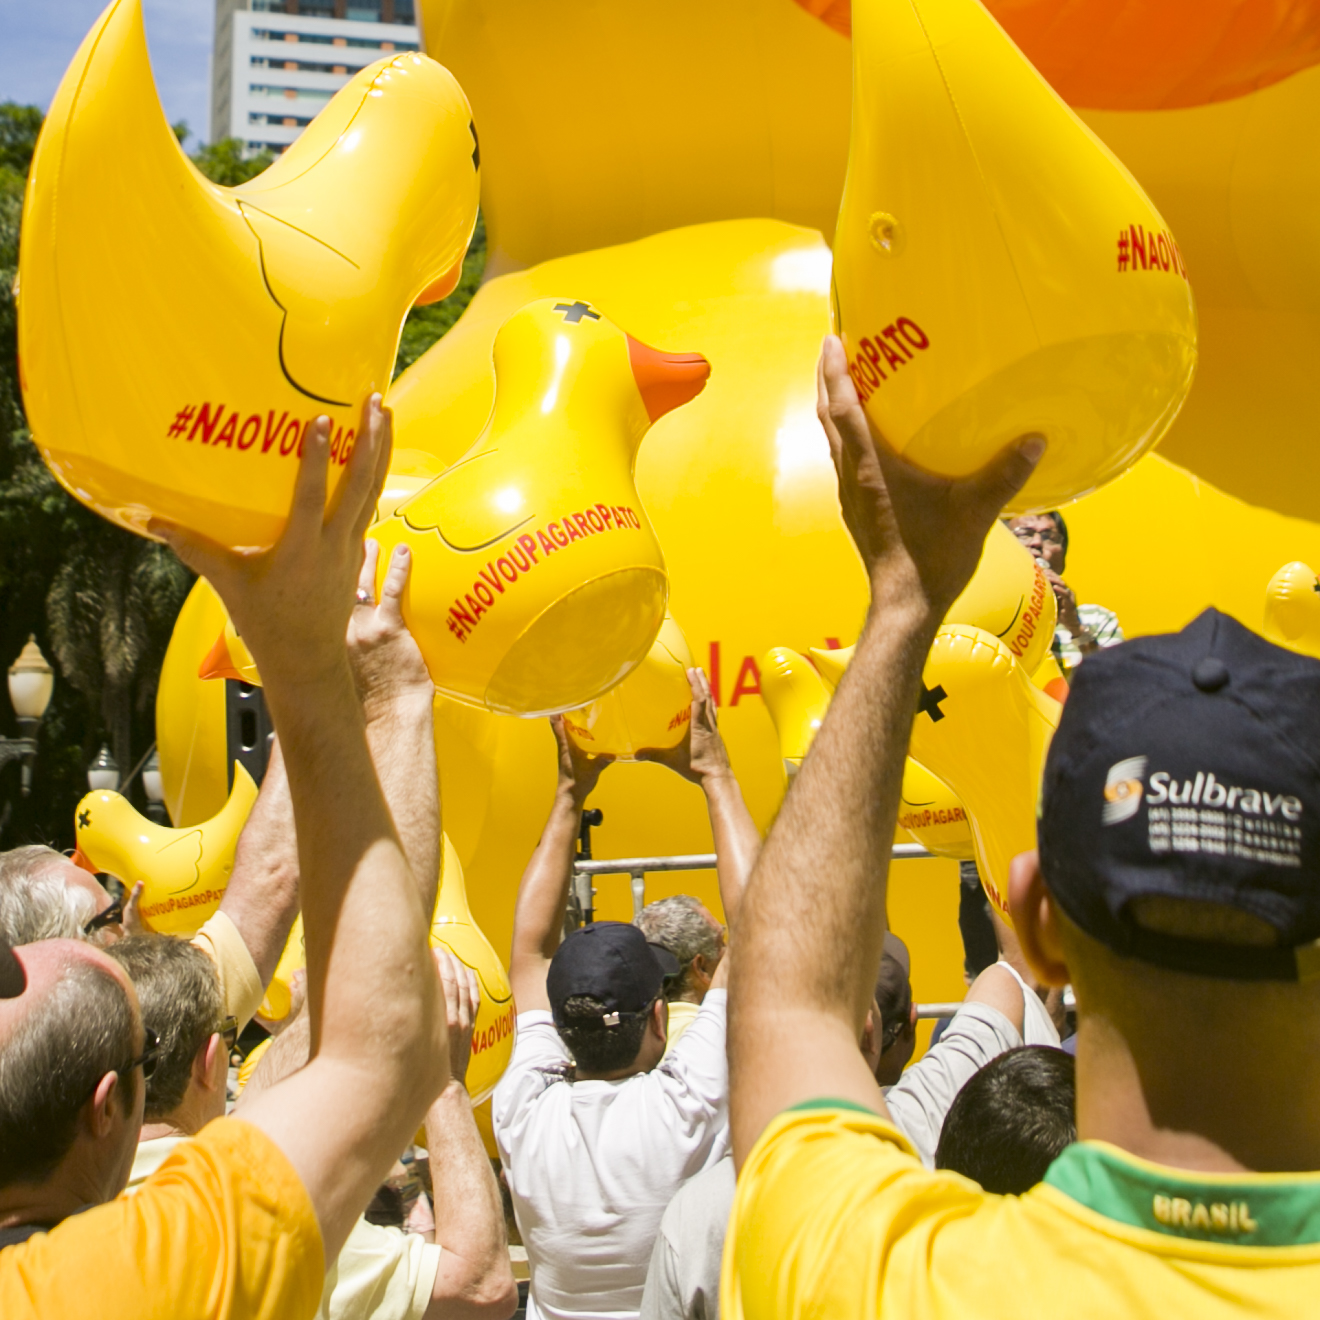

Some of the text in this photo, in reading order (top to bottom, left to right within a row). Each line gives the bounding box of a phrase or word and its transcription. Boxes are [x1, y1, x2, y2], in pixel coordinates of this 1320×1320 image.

[446, 503, 640, 644] #NAOVOUPAGAROPATO
[1146, 771, 1303, 821] Sulbrave
[1153, 1194, 1257, 1233] BRASIL
